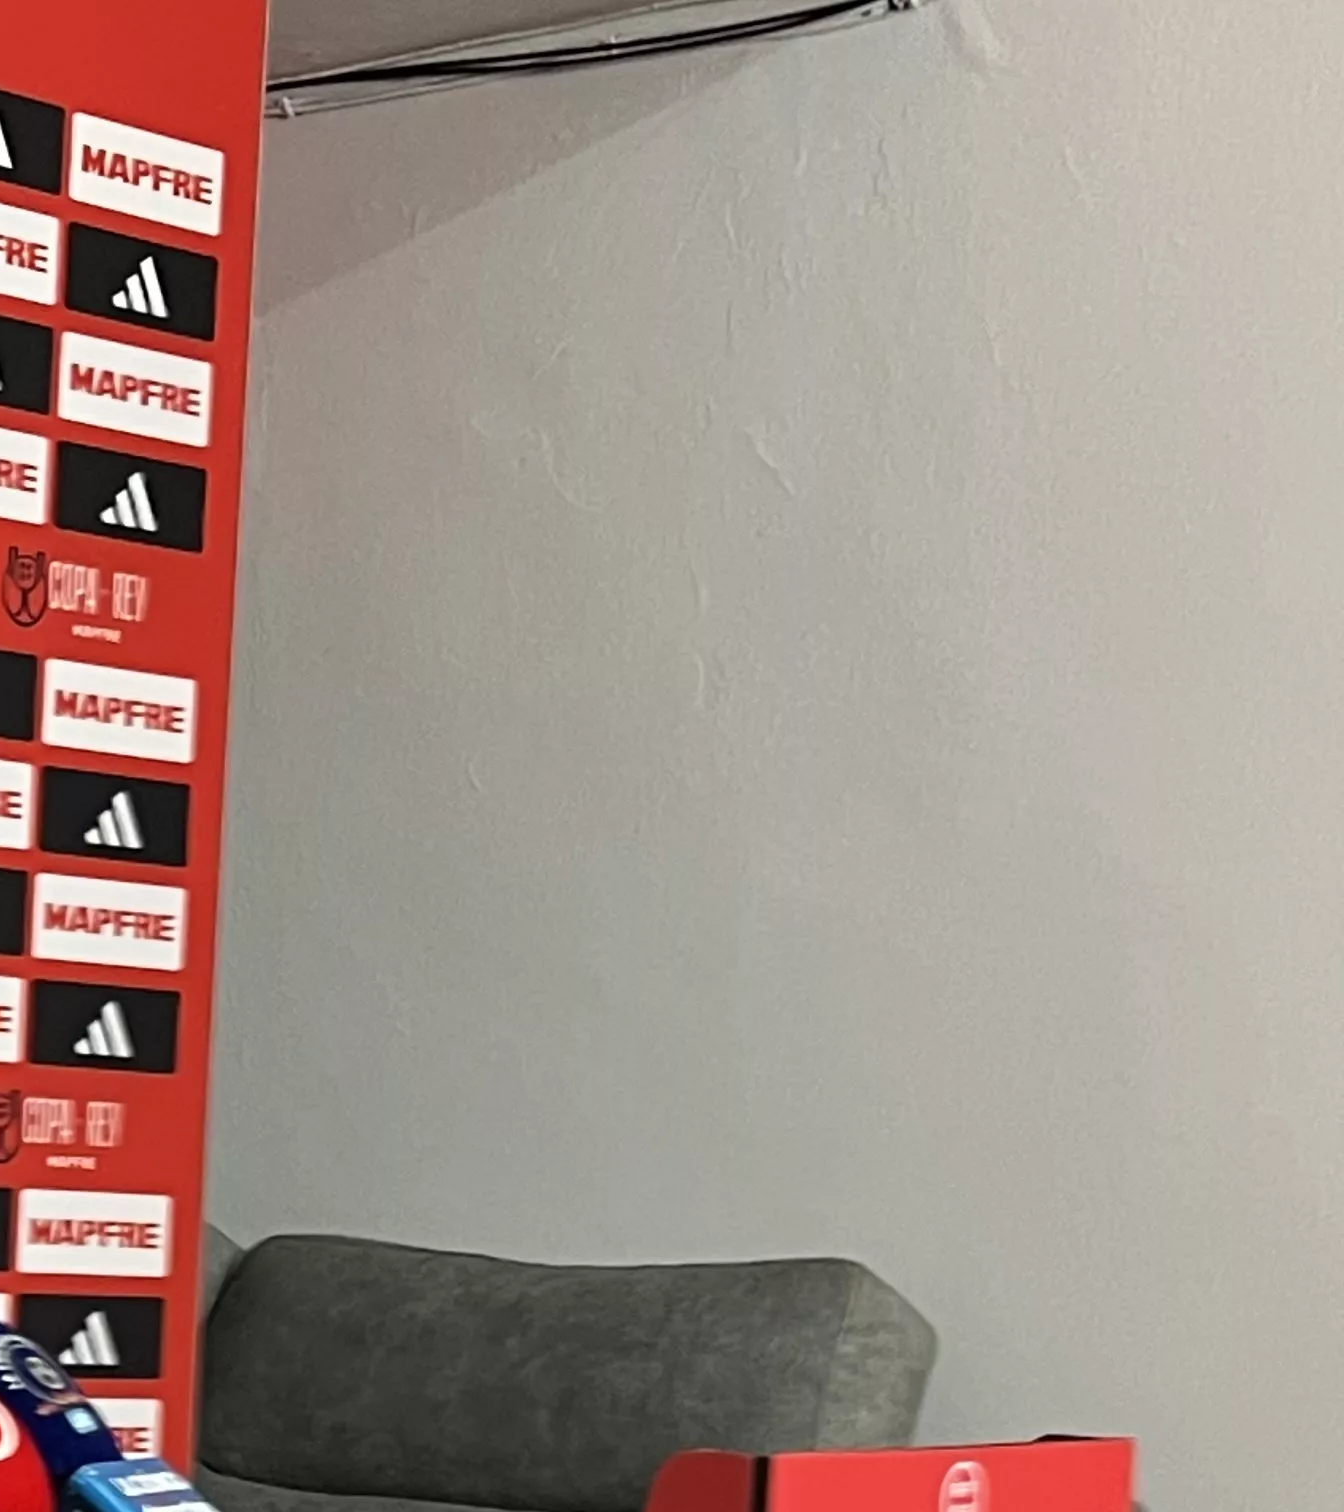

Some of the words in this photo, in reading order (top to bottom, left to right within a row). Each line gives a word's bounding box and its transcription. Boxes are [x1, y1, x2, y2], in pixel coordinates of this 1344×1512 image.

[81, 145, 213, 205] MAPFRE
[70, 363, 202, 417] MAPFRE
[48, 561, 106, 614] COPA
[112, 573, 147, 621] REY
[54, 690, 184, 733] MAPFRE
[44, 903, 175, 941] MAPFRE
[22, 1097, 76, 1144] COPA
[86, 1101, 123, 1147] REY
[29, 1219, 160, 1249] MAPFRE
